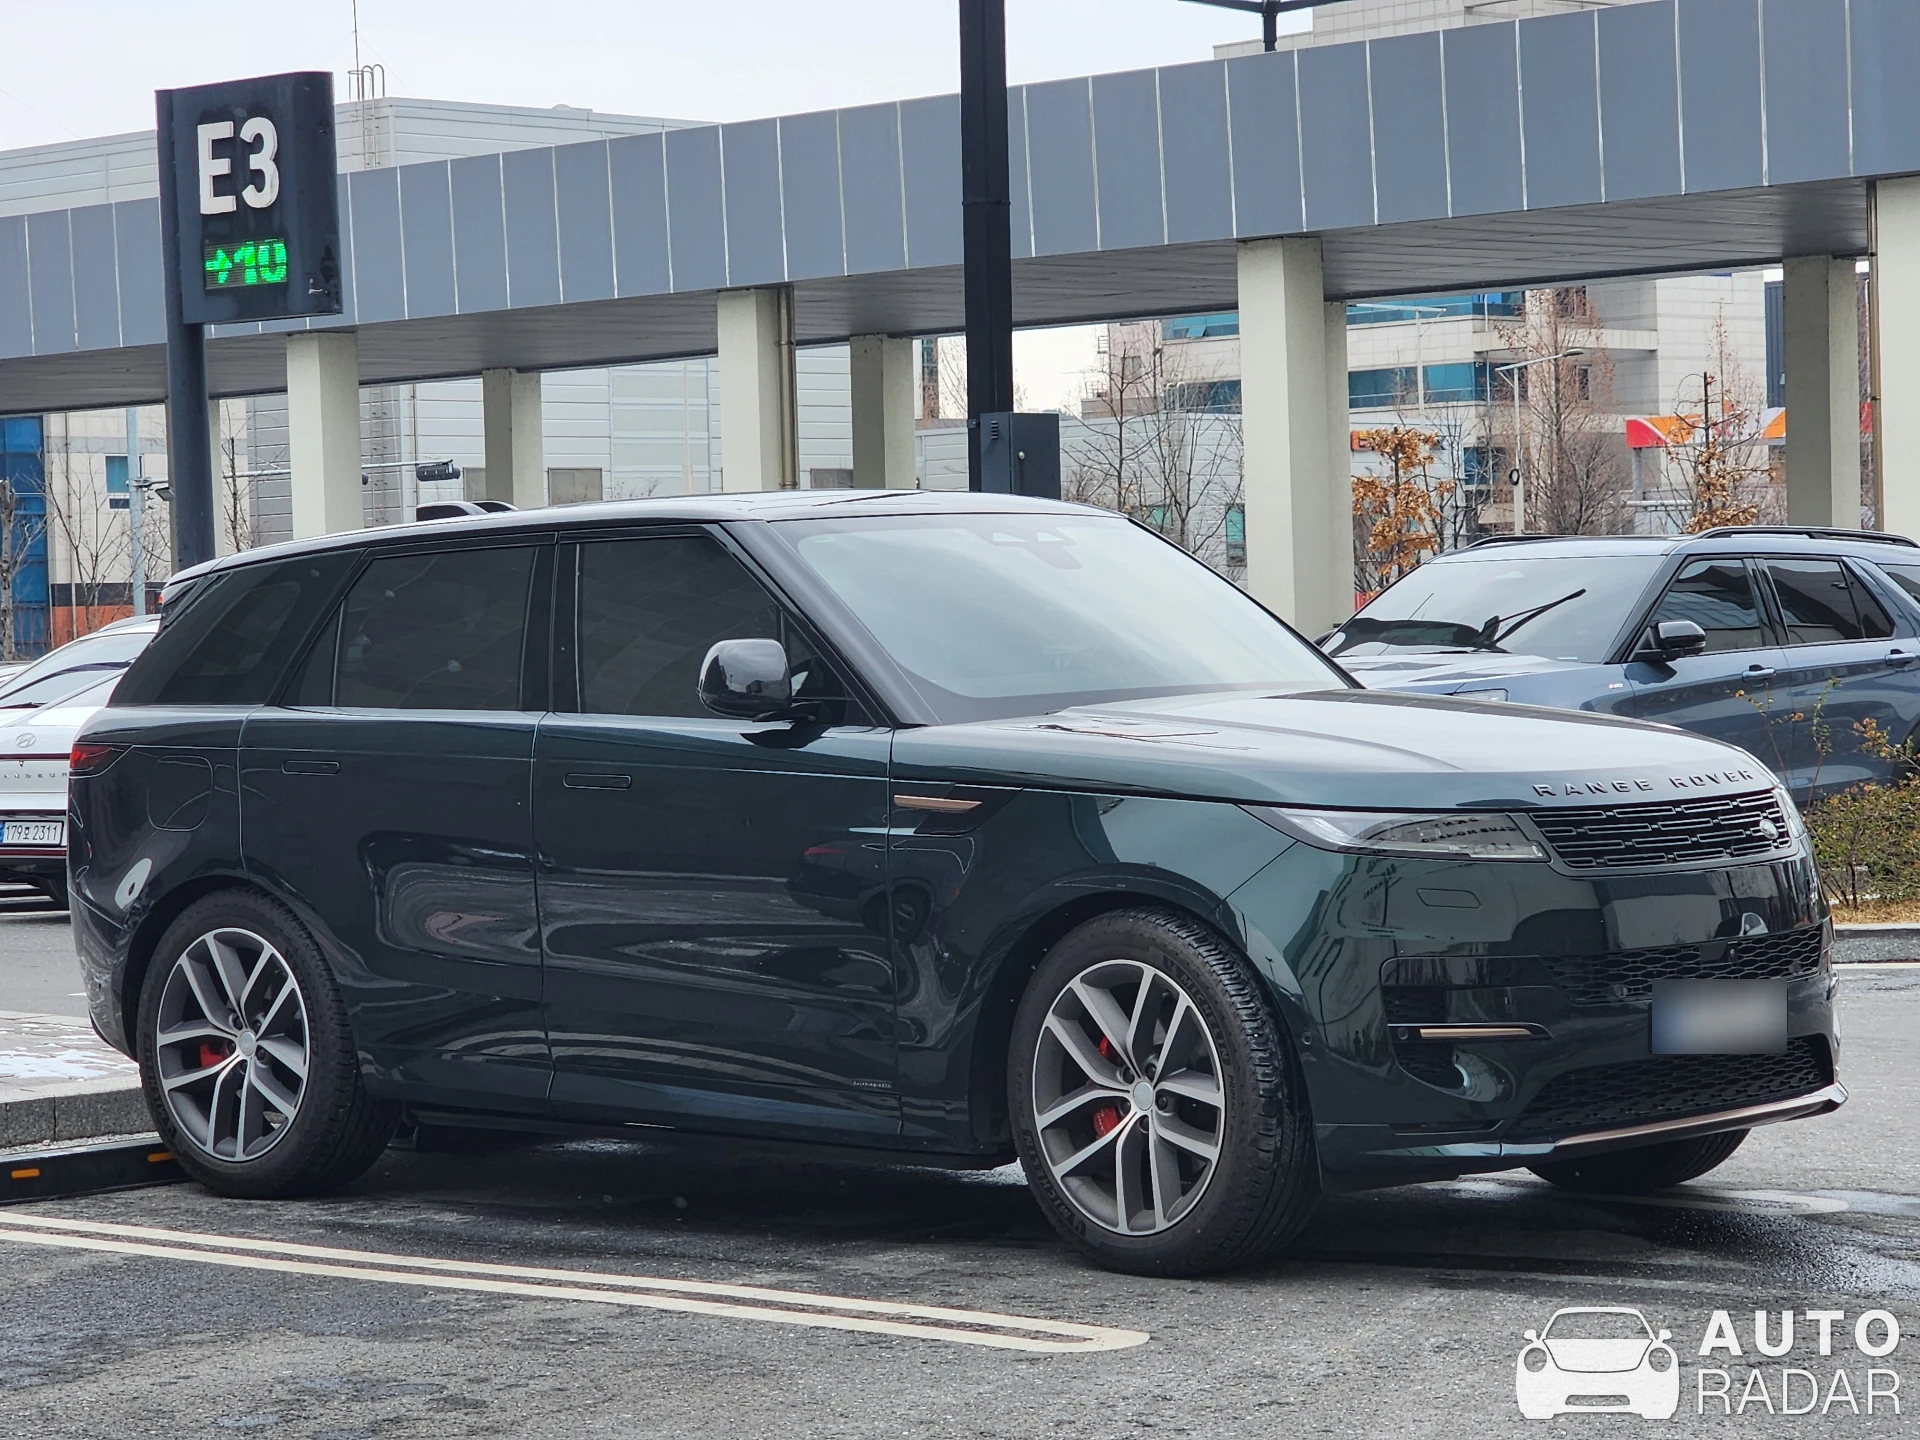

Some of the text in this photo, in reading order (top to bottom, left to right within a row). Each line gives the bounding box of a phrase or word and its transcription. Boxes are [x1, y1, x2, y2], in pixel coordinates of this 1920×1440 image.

[197, 116, 279, 215] E3
[233, 241, 287, 285] 10
[1532, 769, 1754, 797] RANGE ROVER
[32, 824, 58, 841] 2311
